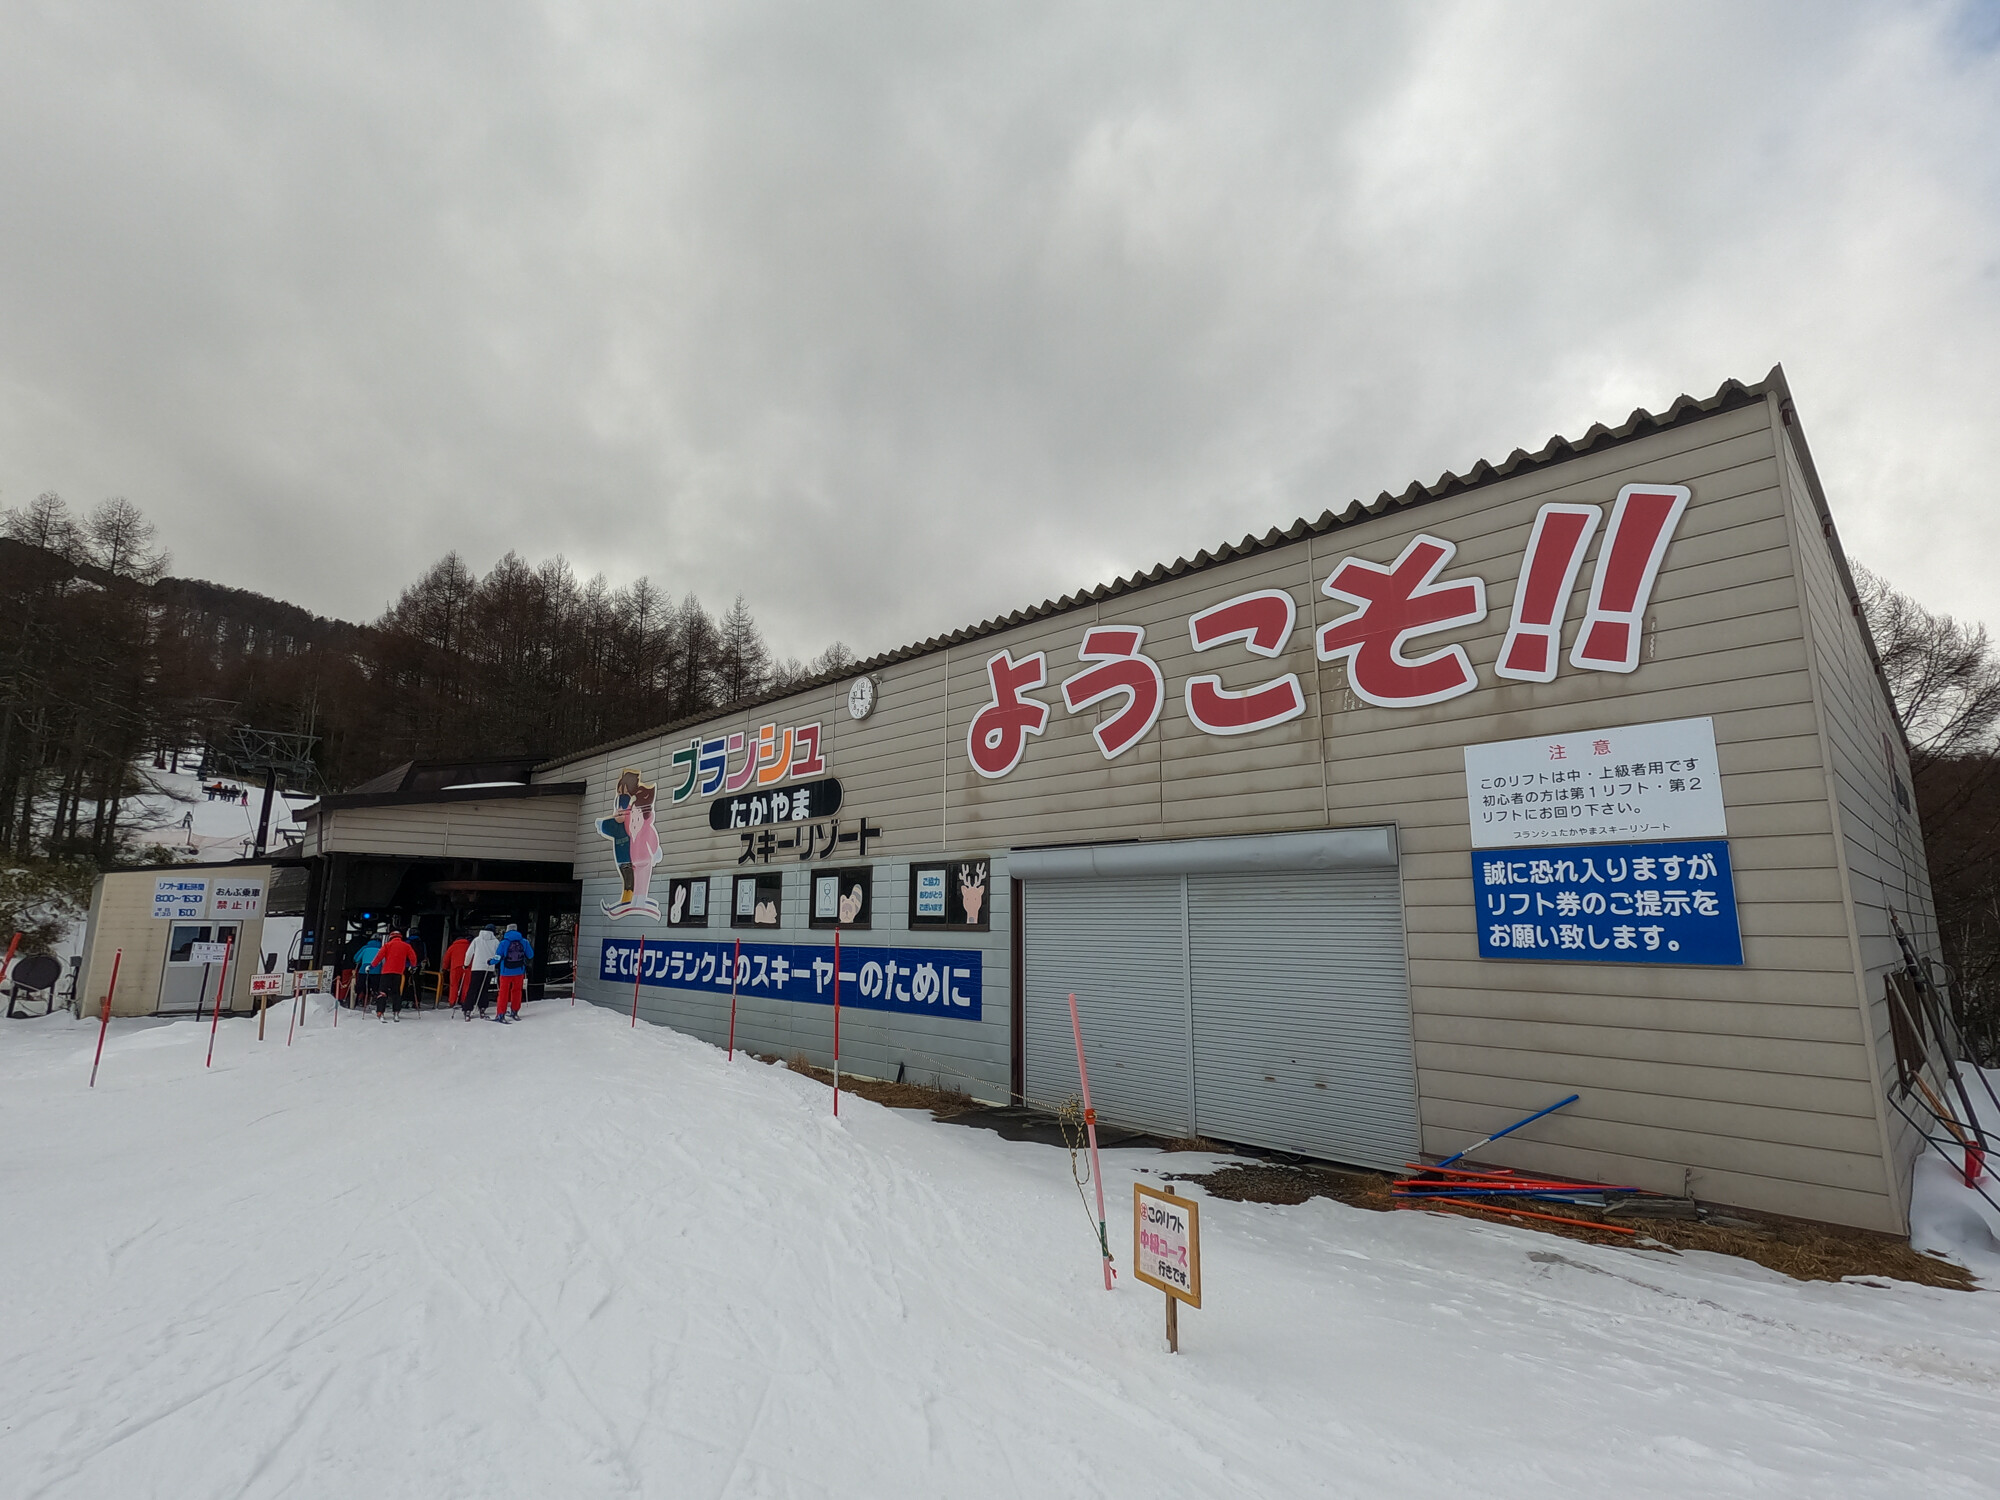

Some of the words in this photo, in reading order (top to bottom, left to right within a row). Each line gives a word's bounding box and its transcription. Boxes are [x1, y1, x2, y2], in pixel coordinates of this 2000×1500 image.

[967, 483, 1691, 779] ようこそ!!
[672, 721, 826, 804] ブランシュ
[1480, 757, 1699, 790] このリフトは中・上級者用です
[730, 788, 811, 829] たかやま
[1482, 801, 1642, 823] リフトにお回り下さい。
[738, 817, 883, 865] スキーリゾート
[1483, 853, 1718, 886] 誠に恐れ入りますが
[216, 888, 261, 897] おんぶ乗車
[1487, 889, 1720, 918] リフト券のご提示を
[1489, 923, 1681, 951] お願い致します。
[253, 980, 280, 991] 禁止
[1140, 1229, 1188, 1268] 中級コース
